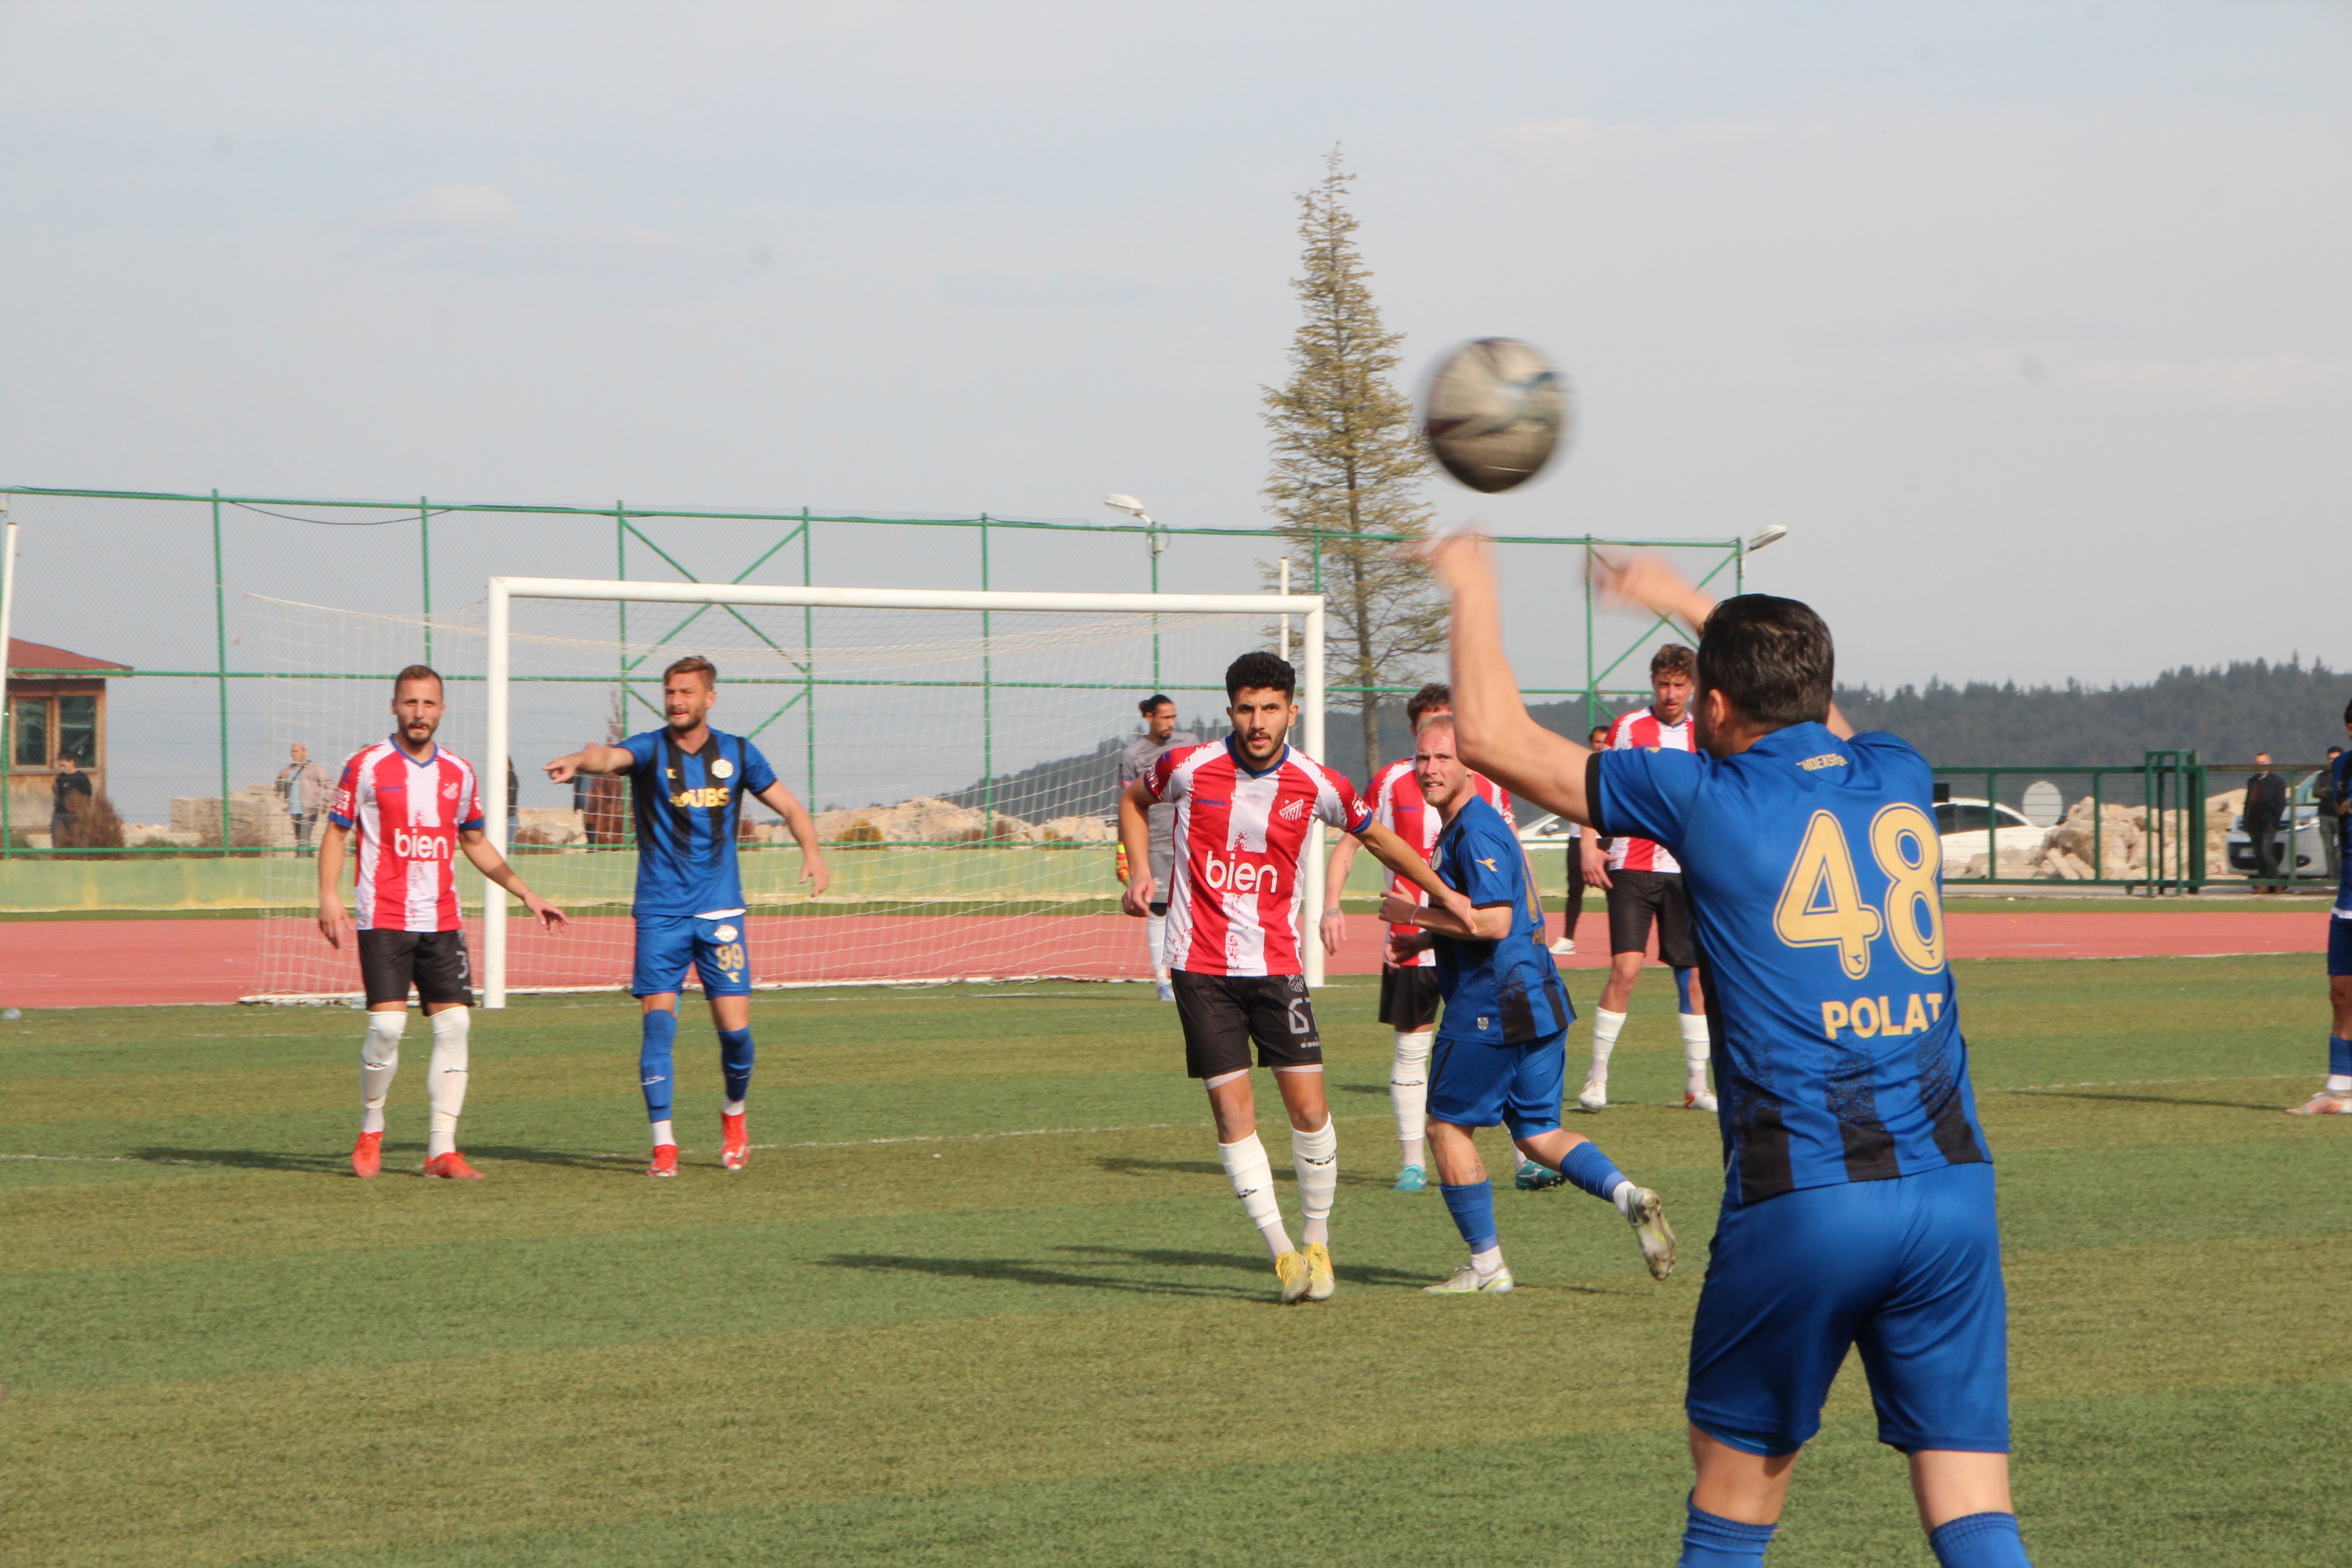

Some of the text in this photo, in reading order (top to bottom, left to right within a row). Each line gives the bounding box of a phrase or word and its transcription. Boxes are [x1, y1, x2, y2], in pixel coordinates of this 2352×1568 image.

[394, 828, 449, 859] bien
[1205, 850, 1278, 893] bien
[1773, 802, 1945, 980] 48
[1821, 993, 1943, 1040] POLAT
